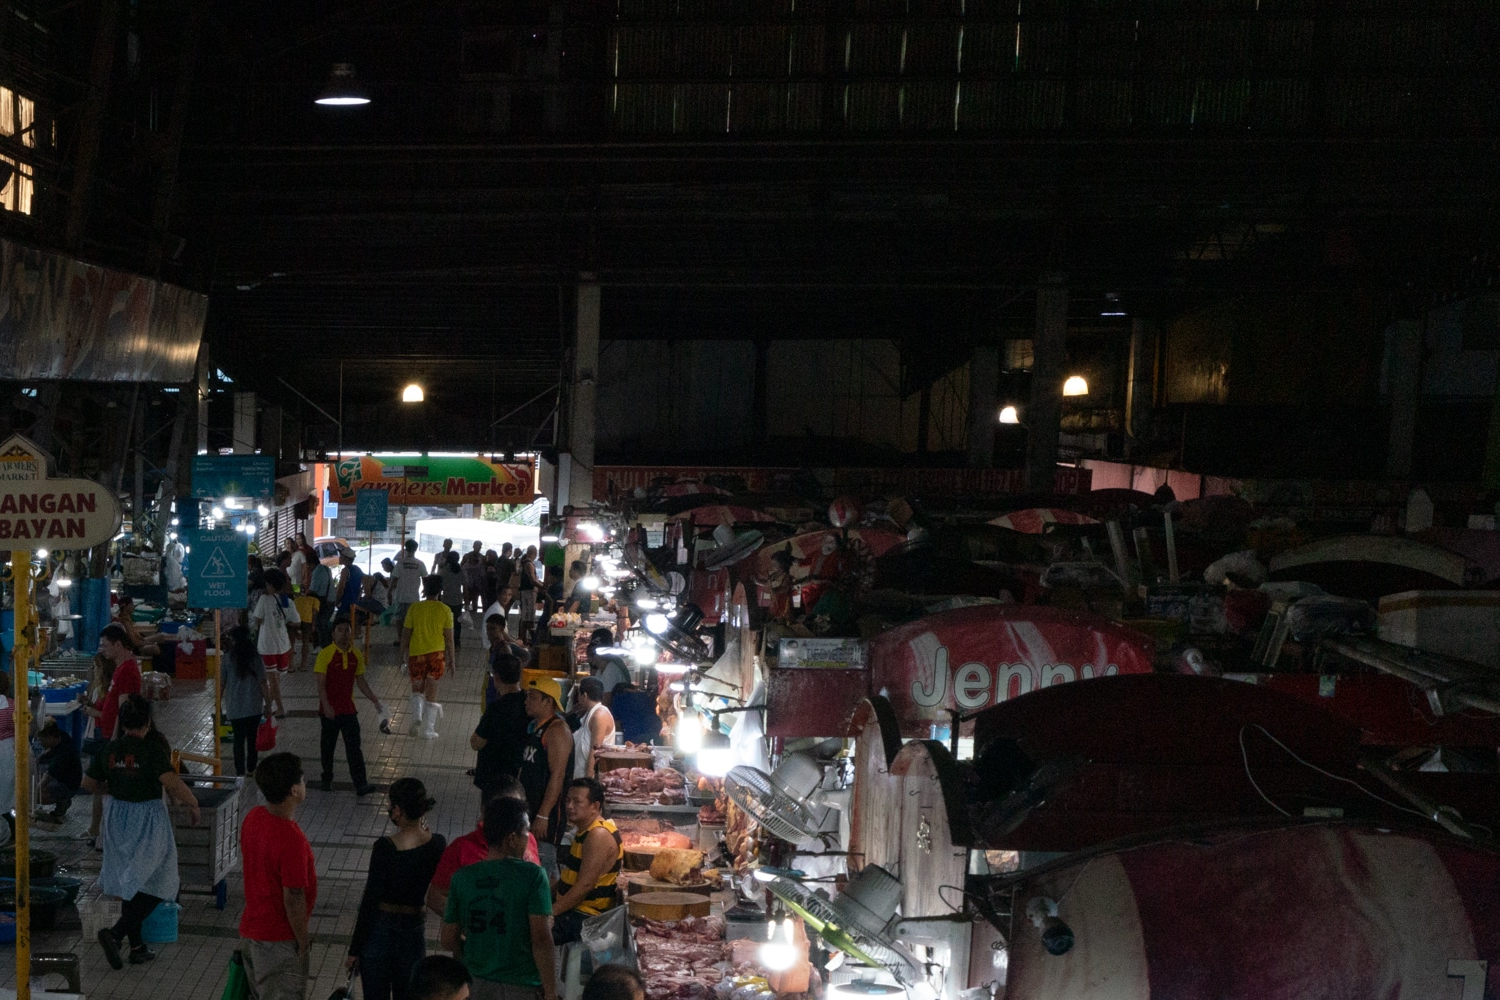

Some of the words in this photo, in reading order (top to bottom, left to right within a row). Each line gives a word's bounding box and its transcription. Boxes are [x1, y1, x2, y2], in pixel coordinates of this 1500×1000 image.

[445, 476, 527, 497] Market
[208, 582, 227, 590] WET
[470, 909, 506, 935] 54
